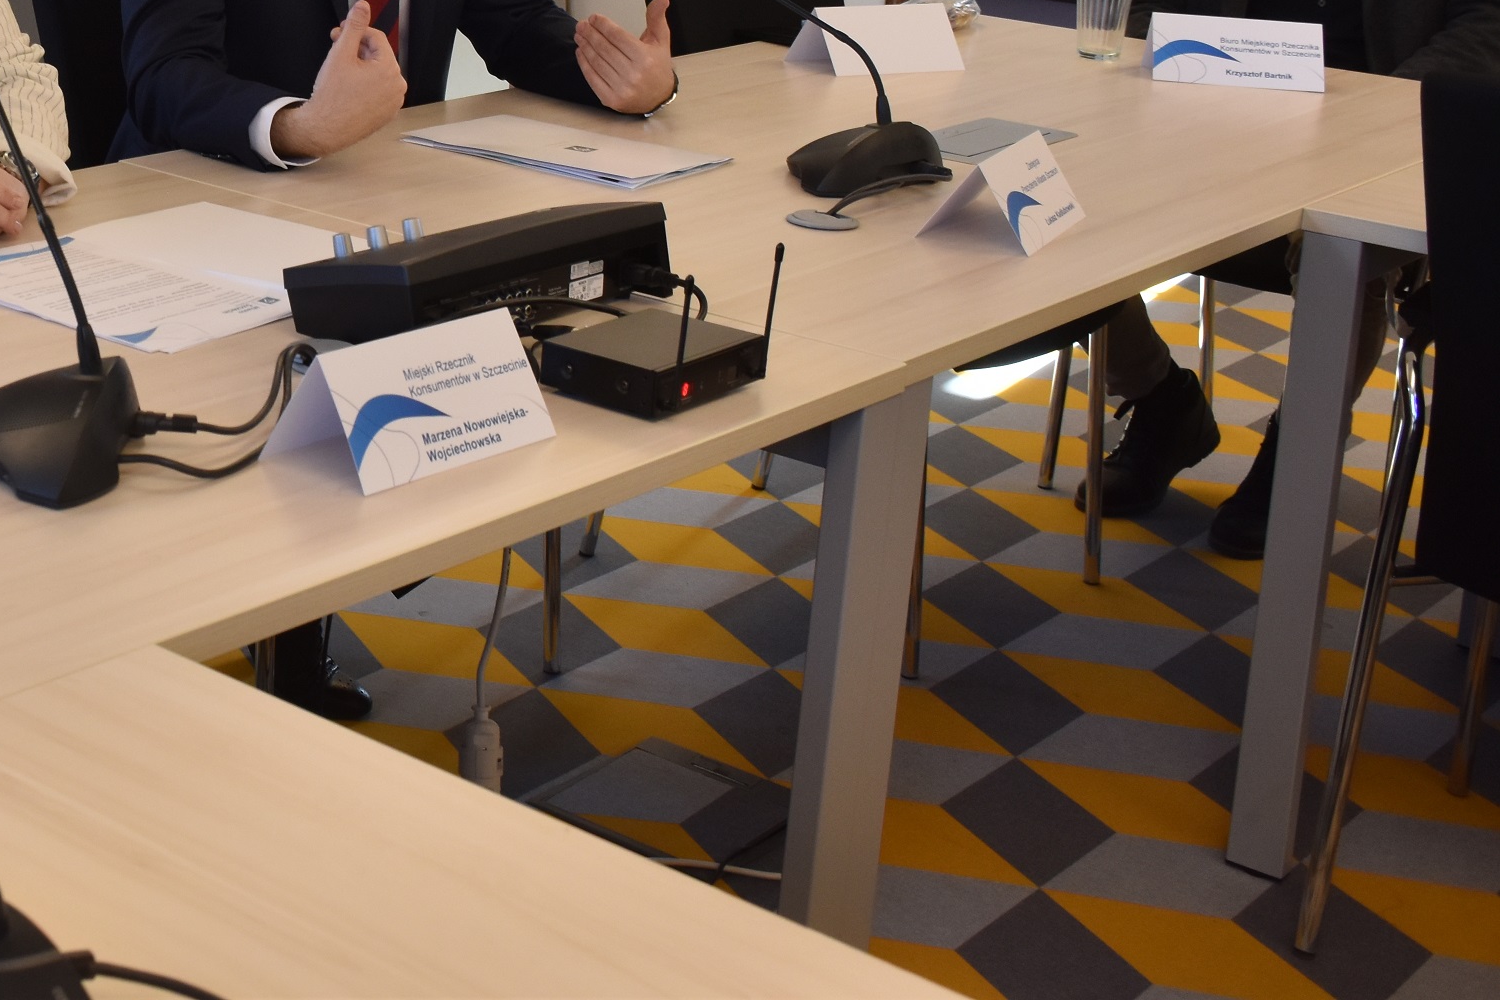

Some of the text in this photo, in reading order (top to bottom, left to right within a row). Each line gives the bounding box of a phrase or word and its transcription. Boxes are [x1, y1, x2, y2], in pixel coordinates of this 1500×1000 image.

[1220, 46, 1271, 55] Konsumentów
[1282, 50, 1320, 58] Szczecinie
[1241, 39, 1279, 48] Miejskiego
[1282, 42, 1319, 50] Rzecznika
[1226, 69, 1262, 78] Krzysztof
[403, 354, 476, 381] Miejski Rzecznik
[408, 358, 528, 398] Konsumentów w Szczecinie
[422, 408, 528, 445] Marzena Nowowiejska-
[426, 432, 502, 462] Wojciechowska
